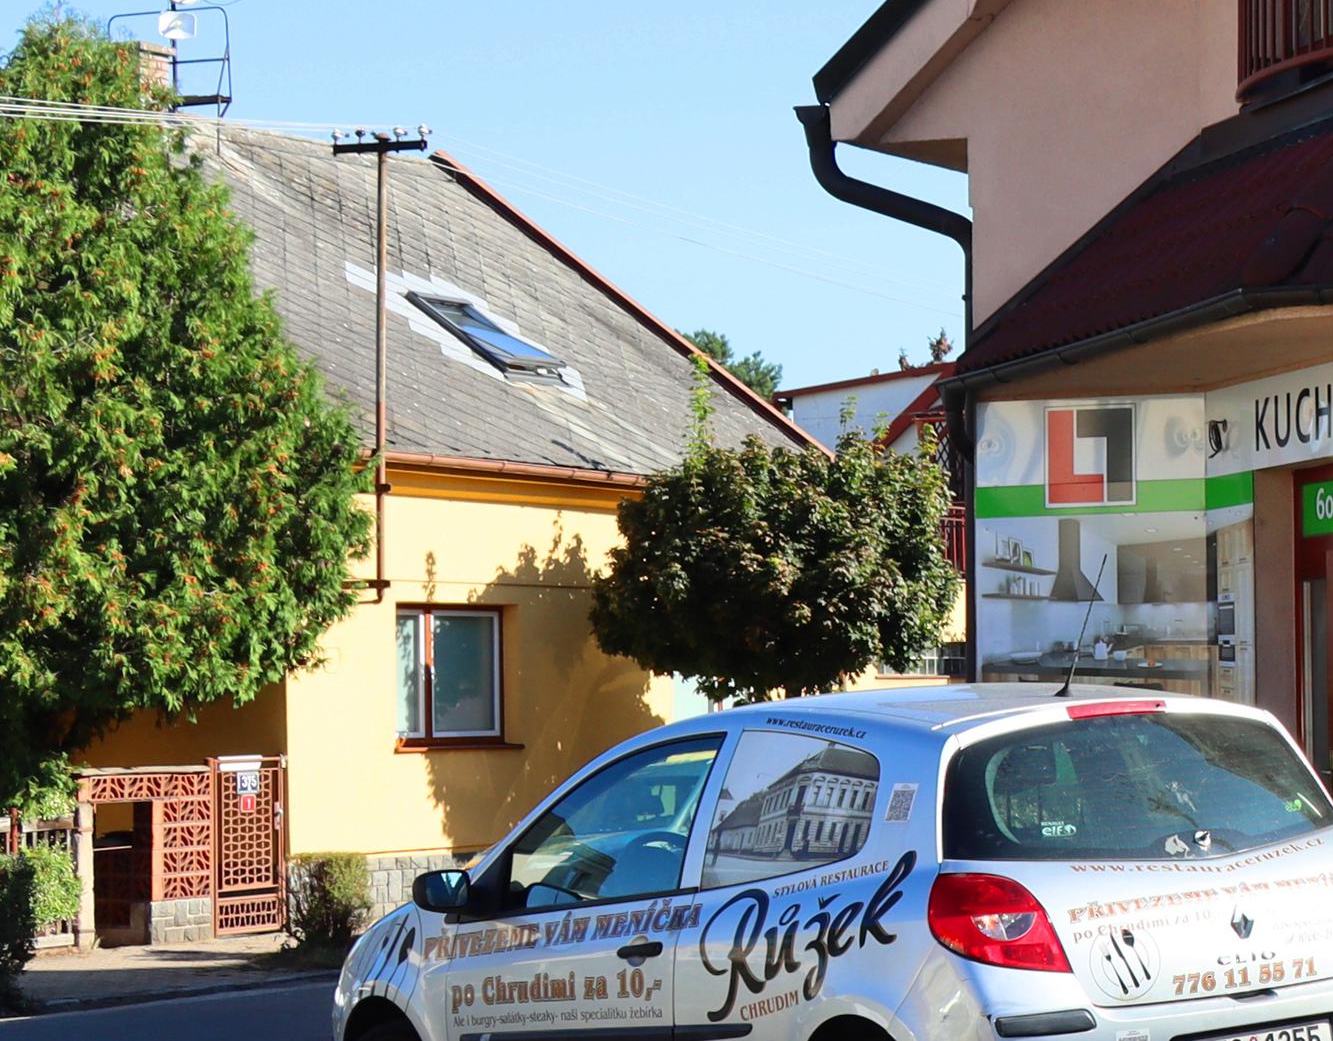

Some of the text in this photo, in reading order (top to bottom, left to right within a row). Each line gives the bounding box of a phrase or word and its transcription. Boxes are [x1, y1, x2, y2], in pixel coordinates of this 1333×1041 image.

[1069, 837, 1325, 872] www.restauraceruzek.cz
[772, 860, 889, 898] STYLOVÁ RESTAURACE
[699, 850, 917, 1022] Růžek
[451, 984, 476, 1014] po
[481, 970, 577, 1007] Chrudimi
[583, 976, 608, 1000] za
[1173, 956, 1318, 996] 776 11 55 71
[740, 989, 799, 1021] CHRUDIM
